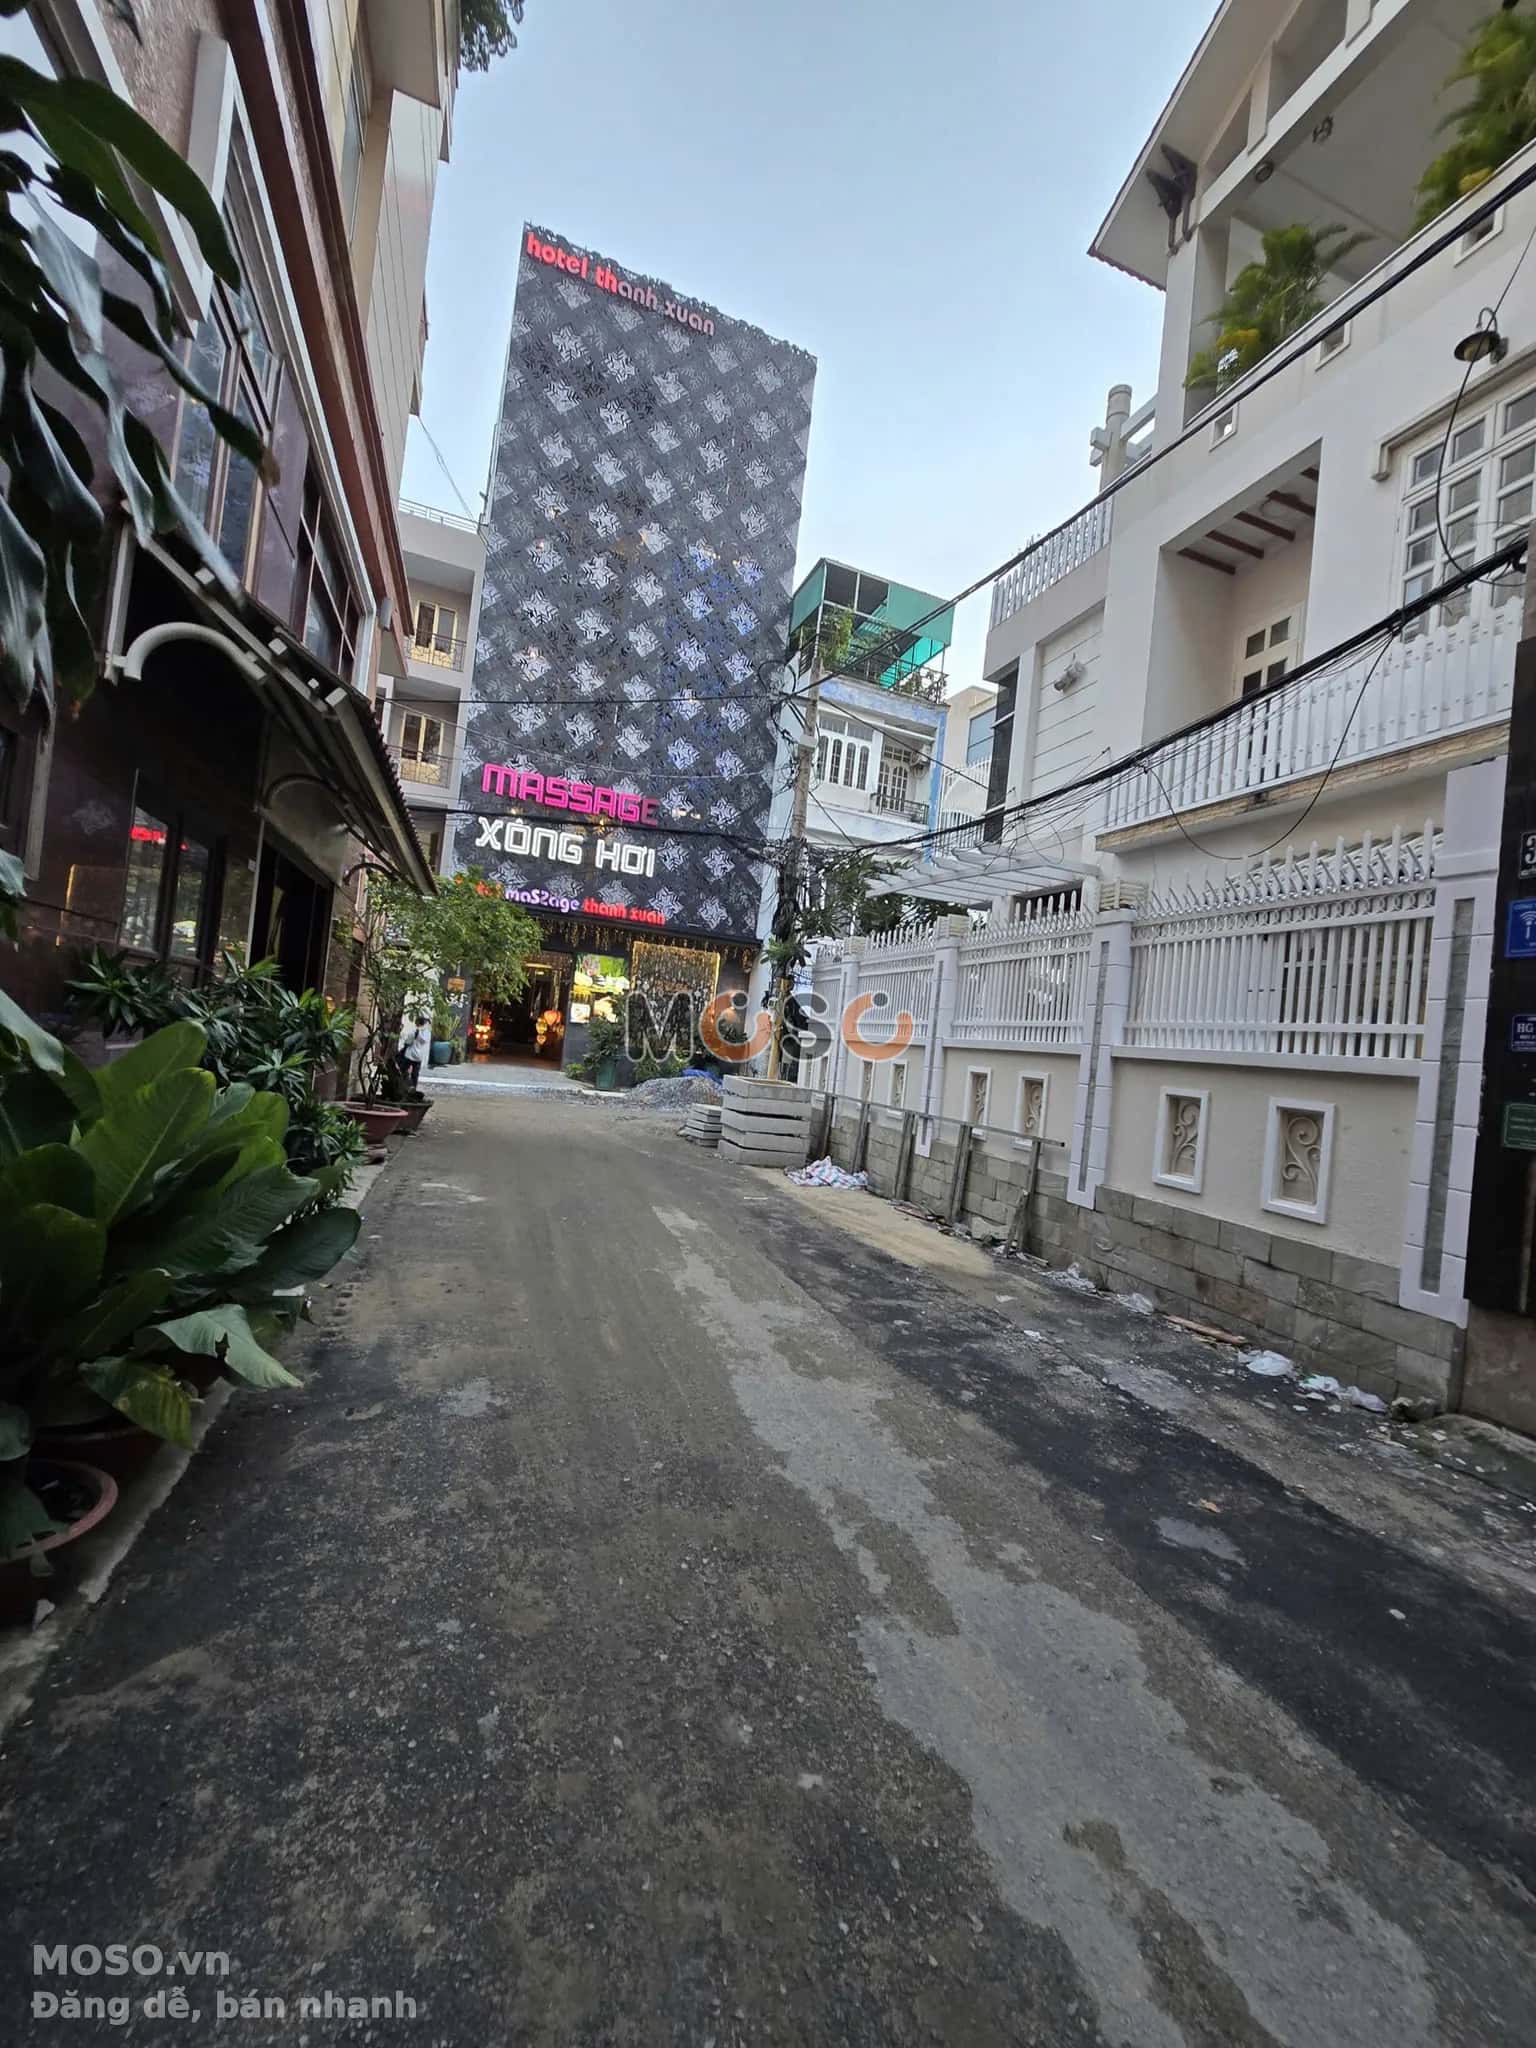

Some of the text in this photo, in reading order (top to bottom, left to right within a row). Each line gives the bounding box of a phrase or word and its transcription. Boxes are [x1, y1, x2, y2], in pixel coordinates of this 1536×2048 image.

[526, 231, 715, 337] hotel thanh xuan
[481, 763, 659, 825] MASSAGE
[582, 896, 626, 919] thanh
[630, 907, 665, 927] xuan
